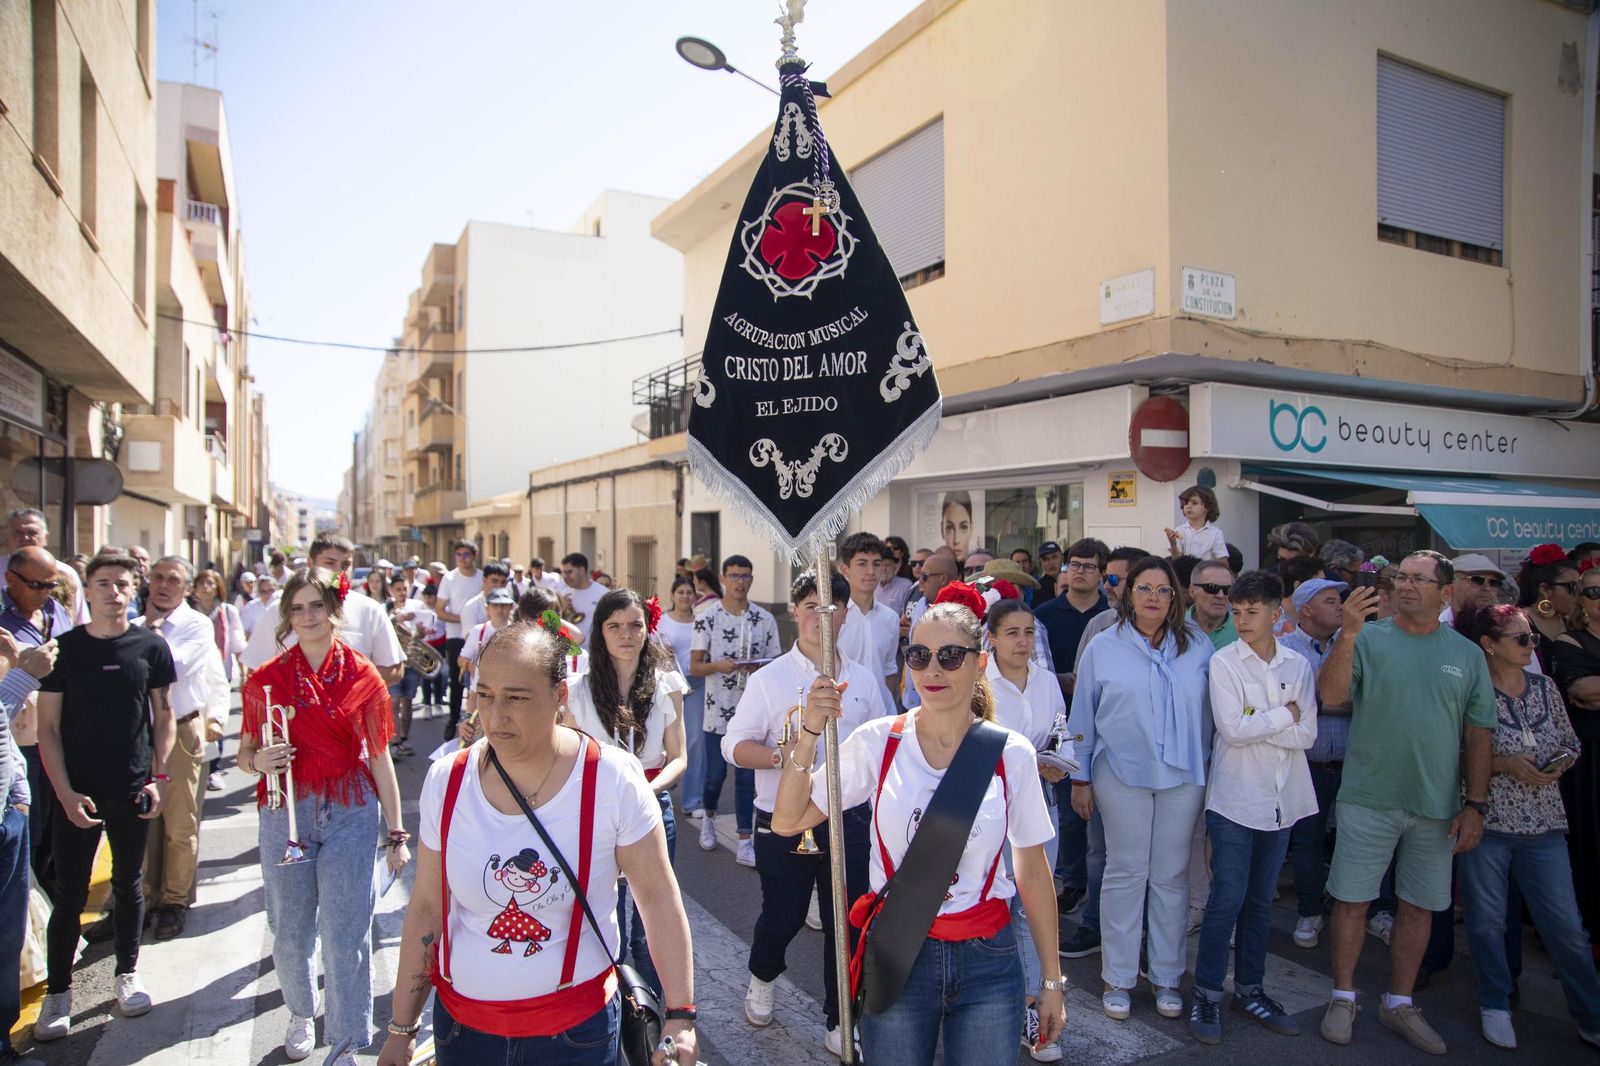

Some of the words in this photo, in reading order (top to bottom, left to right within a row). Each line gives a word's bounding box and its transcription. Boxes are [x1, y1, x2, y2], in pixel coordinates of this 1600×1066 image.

[1200, 273, 1225, 288] PLAZA
[1202, 288, 1211, 296] DE
[1213, 289, 1221, 297] LA
[1184, 295, 1233, 315] CONSTITUCION
[723, 311, 807, 350] AGRUPACION
[807, 306, 869, 347] MUSICAL
[724, 355, 779, 382] CRISTO
[782, 354, 814, 381] DEL
[818, 351, 868, 378] AMOR
[755, 400, 779, 417] EL
[781, 396, 838, 415] EJIDO
[1338, 416, 1431, 454] beauty
[1443, 429, 1518, 454] center
[1513, 515, 1564, 543] beauty
[1567, 518, 1600, 538] cent
